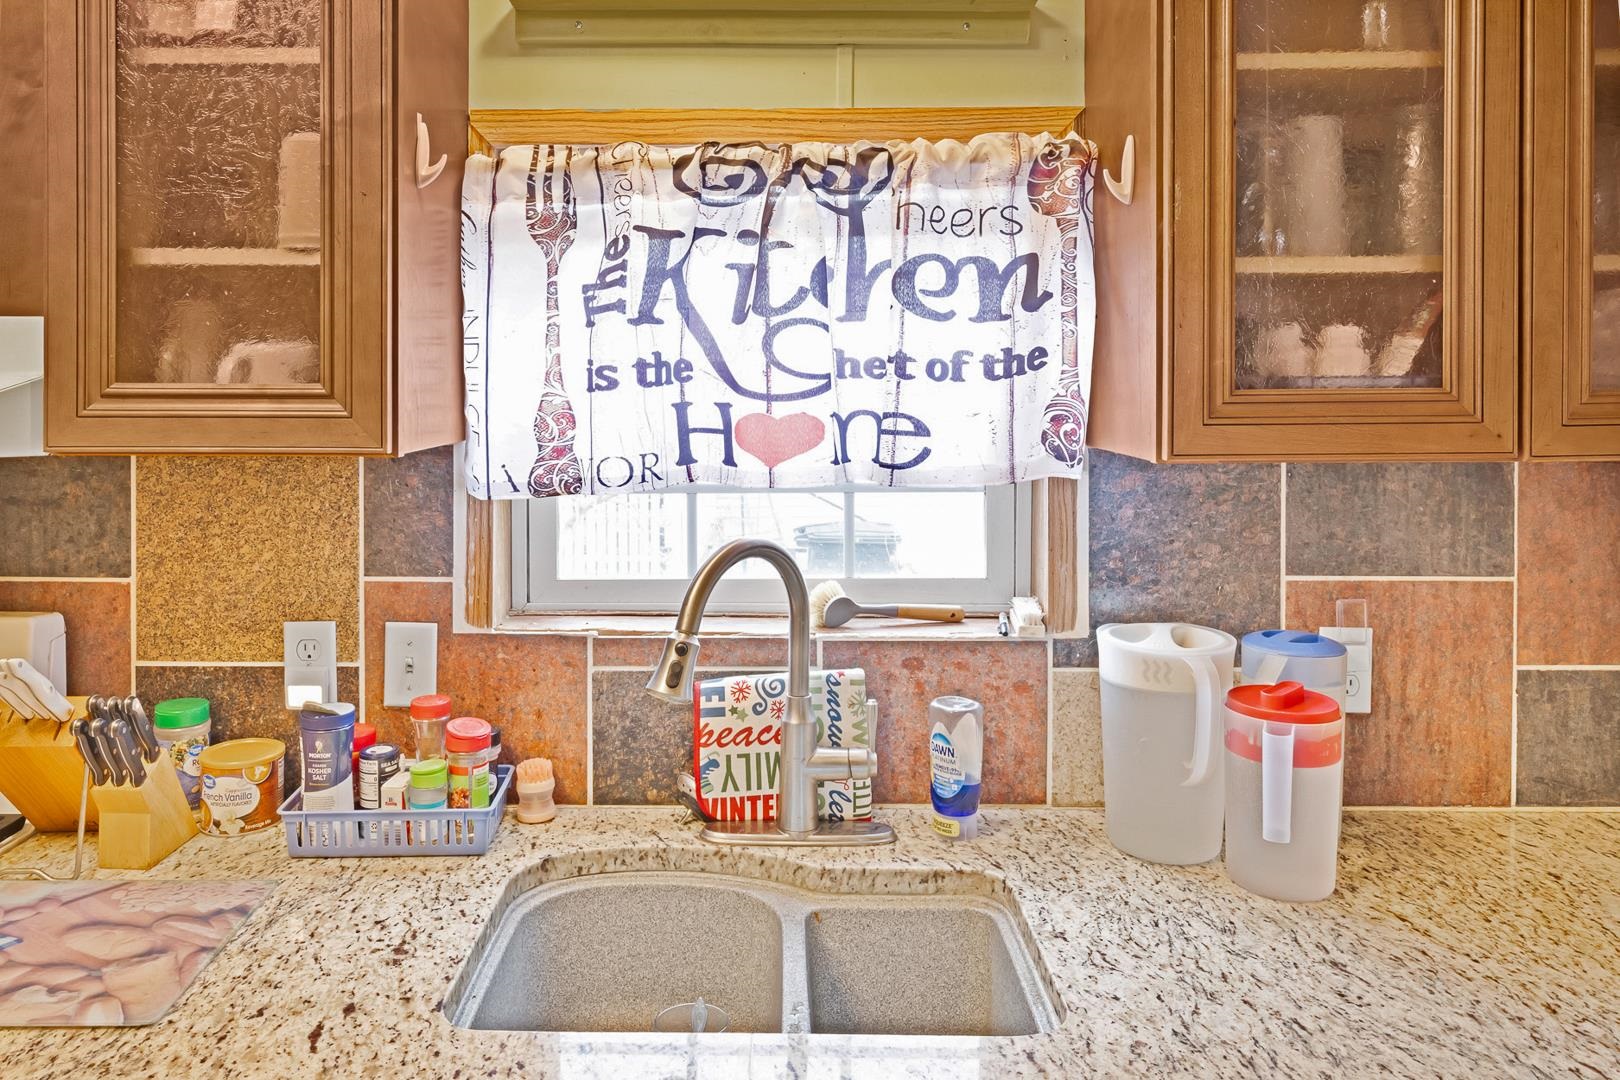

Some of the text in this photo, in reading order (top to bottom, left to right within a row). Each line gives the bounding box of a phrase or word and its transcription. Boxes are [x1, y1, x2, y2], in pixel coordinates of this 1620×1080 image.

[581, 234, 631, 329] The
[586, 358, 620, 393] is
[632, 350, 694, 389] the
[925, 350, 974, 382] of
[979, 345, 1048, 382] the
[931, 741, 956, 759] DAWN
[224, 791, 253, 802] Vanilla
